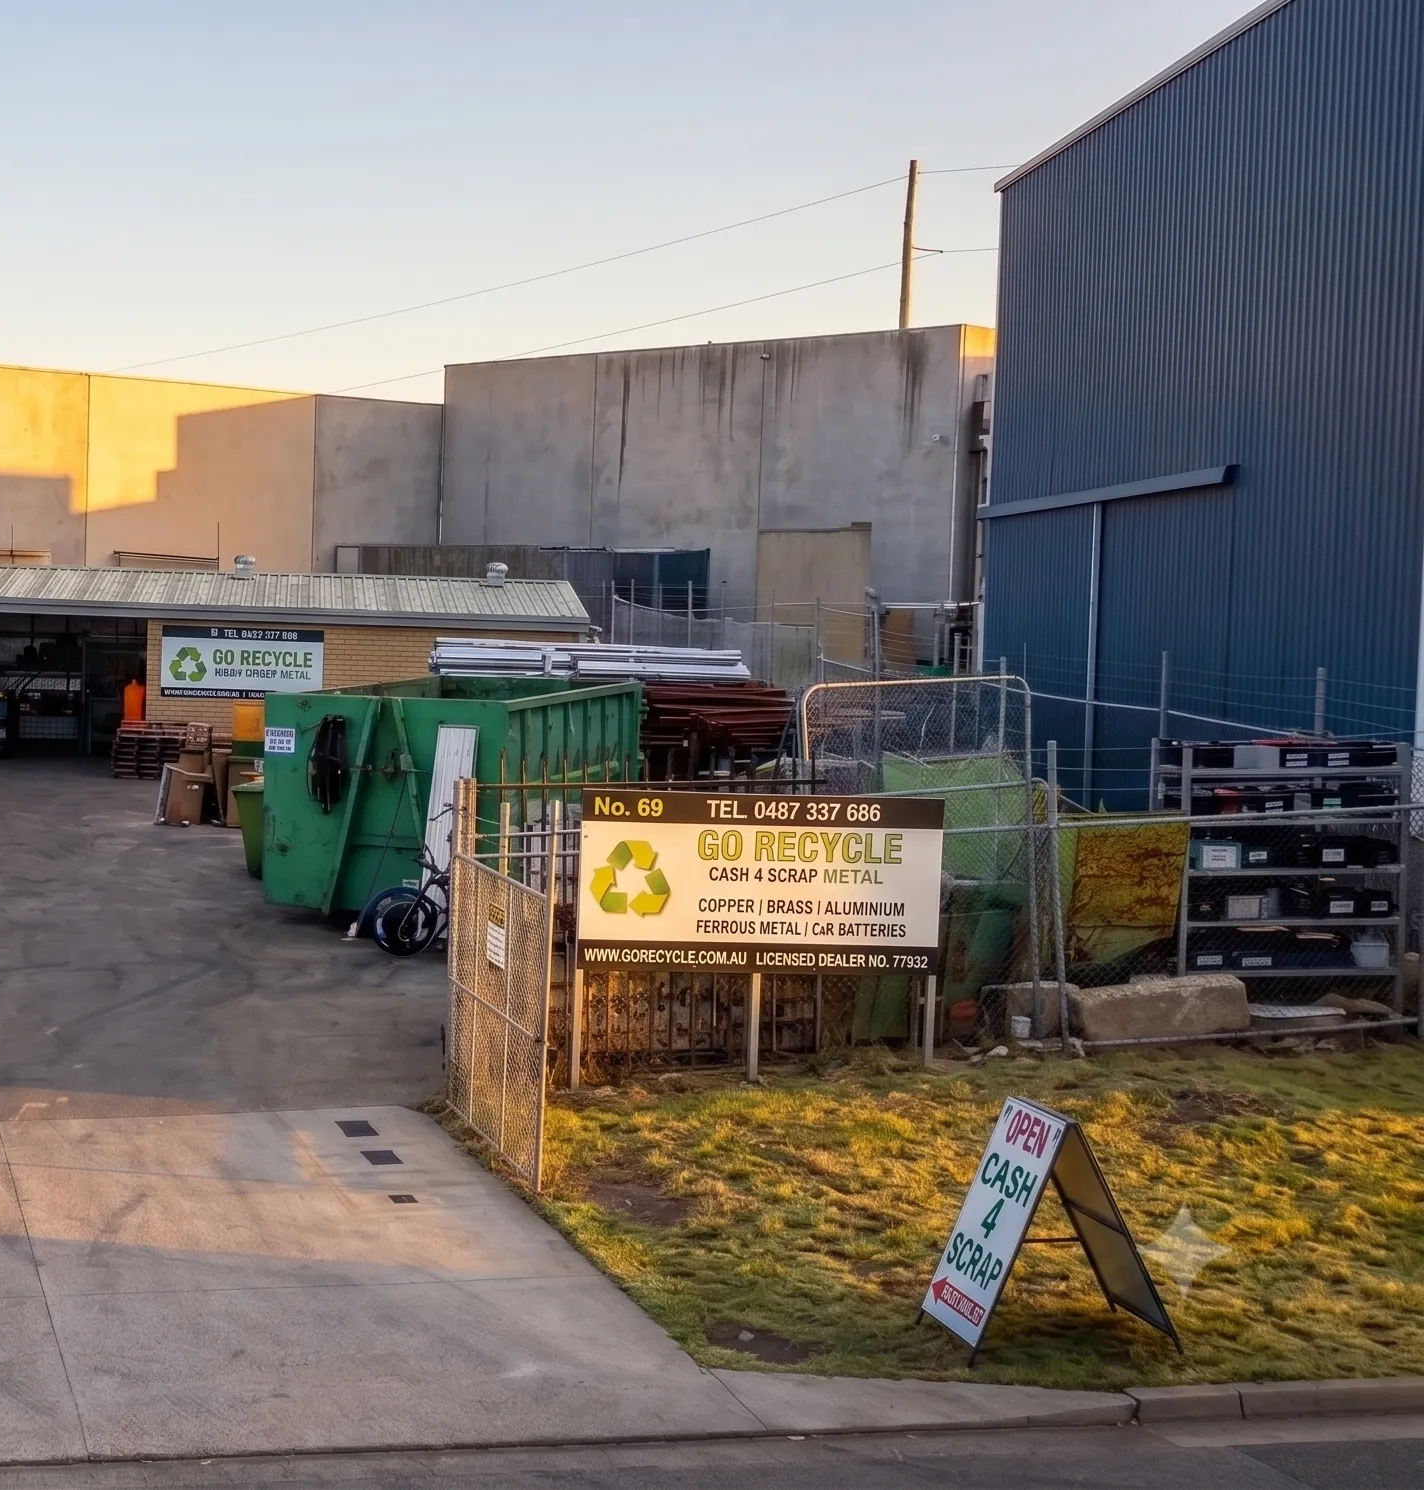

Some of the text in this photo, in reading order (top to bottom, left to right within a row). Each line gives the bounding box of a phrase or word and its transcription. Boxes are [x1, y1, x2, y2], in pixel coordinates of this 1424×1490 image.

[212, 648, 313, 668] GO RECYCLE
[280, 670, 312, 680] METAL
[594, 797, 663, 817] No. 69
[707, 800, 881, 822] TEL. 0487 337 686
[697, 829, 904, 865] GO RECYCLE
[709, 867, 884, 885] CASH 4 SCRAP METAL
[698, 898, 754, 914] COPPER
[766, 899, 813, 915] BRASS
[824, 900, 905, 917] ALUMINIUM
[696, 920, 756, 935] FERROUS
[759, 921, 801, 937] METAL
[838, 923, 906, 938] BATTERIES
[584, 948, 928, 969] WWW.GORECYCLE.COM.AU LICENSED DEALER NO. 77932
[1006, 1109, 1052, 1159] OPEN
[981, 1153, 1038, 1207] CASH
[981, 1198, 1005, 1239] 4
[946, 1232, 1003, 1290] SCRAP
